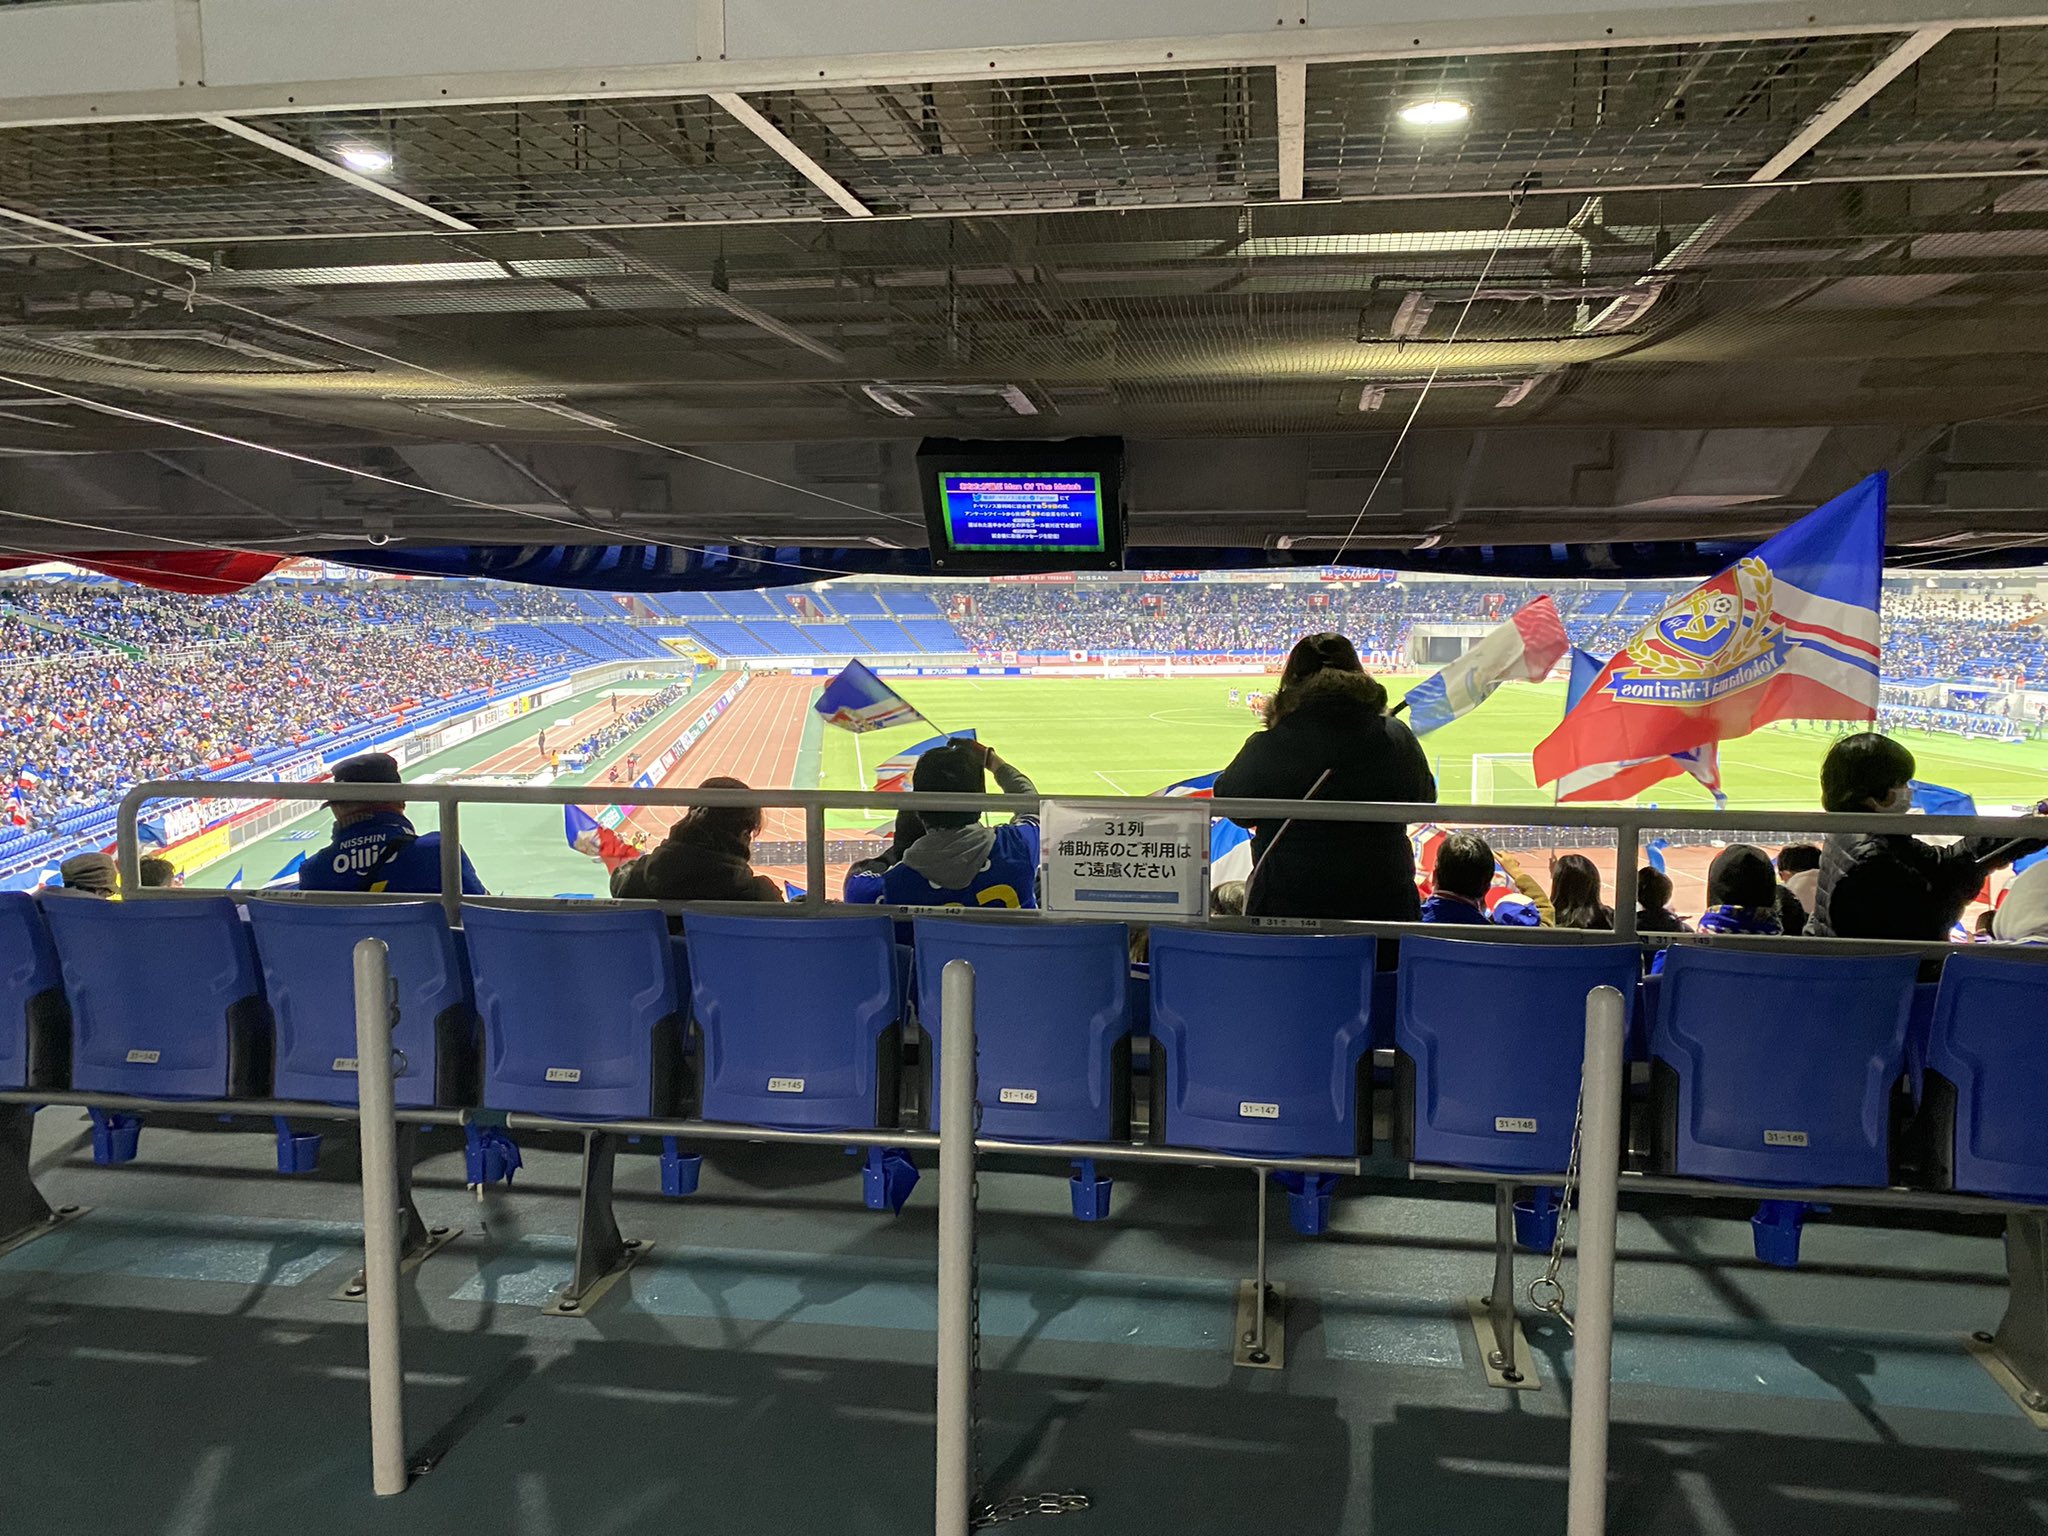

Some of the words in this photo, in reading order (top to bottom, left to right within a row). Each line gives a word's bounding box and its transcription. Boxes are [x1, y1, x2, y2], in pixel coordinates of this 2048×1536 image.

[1024, 482, 1035, 491] Of
[1036, 482, 1053, 491] The
[1104, 821, 1144, 837] 31列
[340, 833, 387, 850] NISSHIN
[1058, 840, 1192, 859] 補助席のご利用は
[1073, 861, 1176, 879] ご遠慮ください
[1300, 919, 1317, 927] 144
[771, 1080, 802, 1090] 31-145
[1003, 1090, 1035, 1101] 31-146
[1242, 1104, 1276, 1115] 31-147
[1499, 1119, 1533, 1130] 31-148
[1767, 1132, 1805, 1143] 31-149
